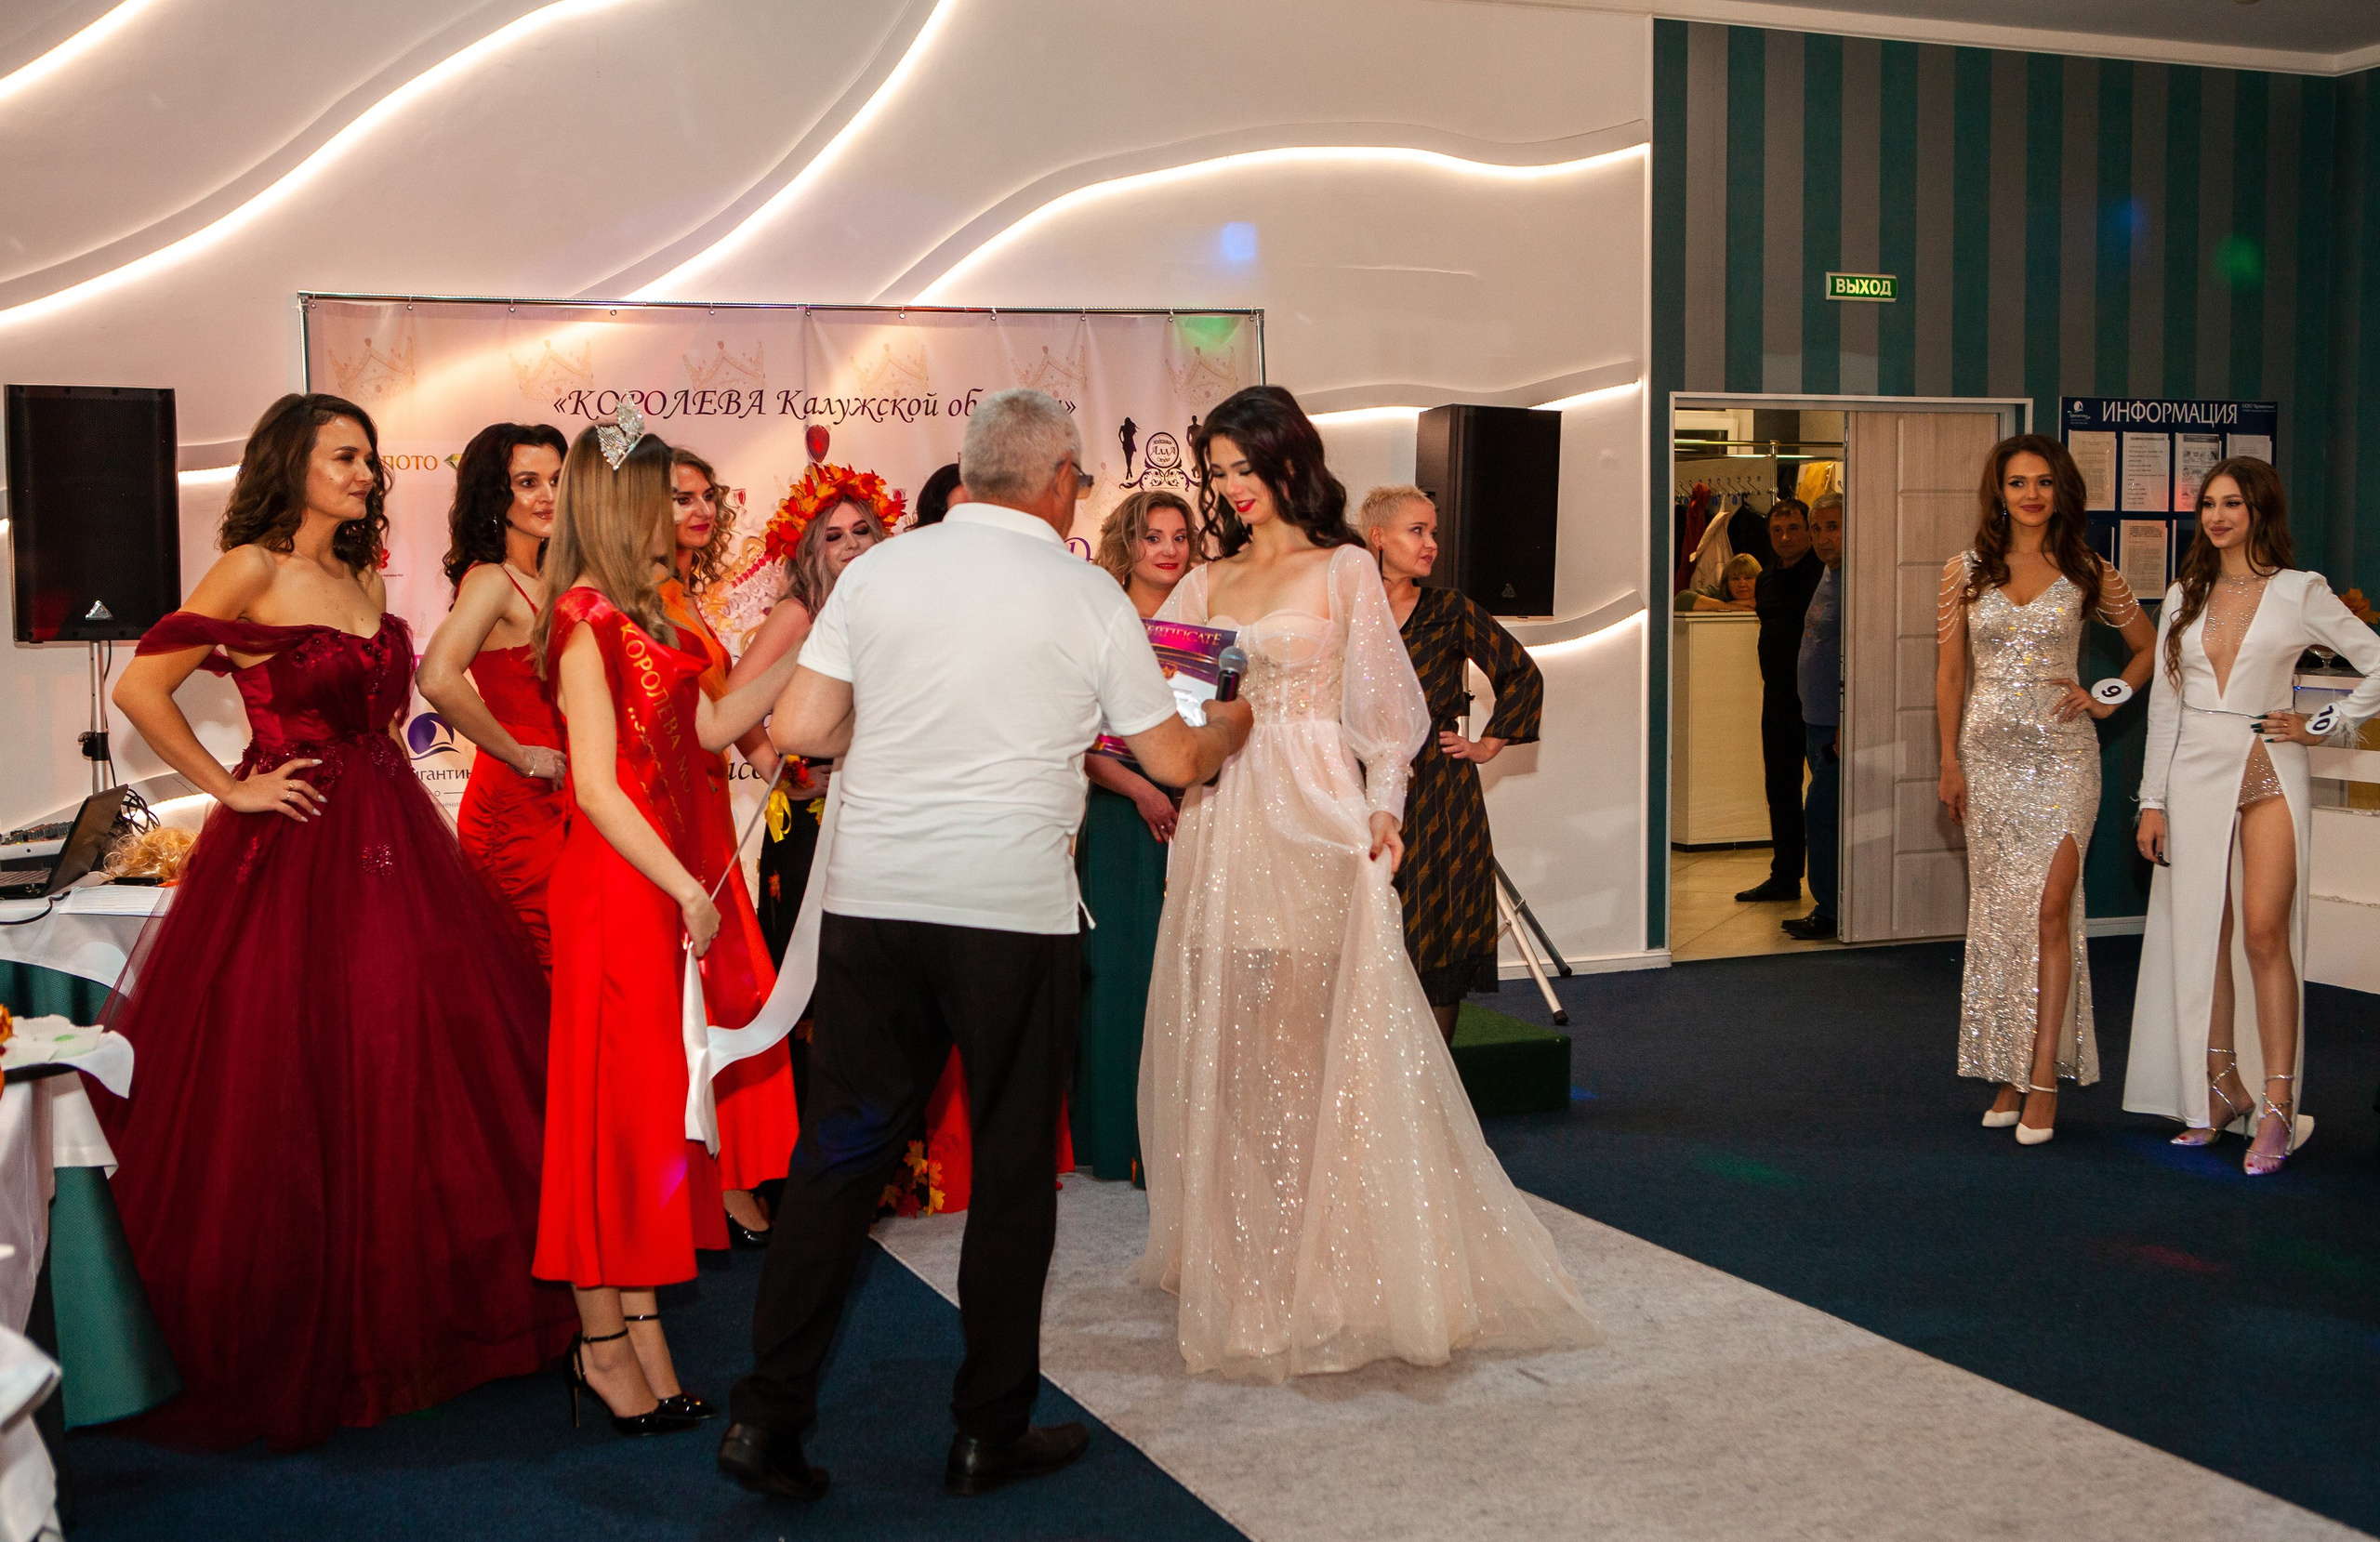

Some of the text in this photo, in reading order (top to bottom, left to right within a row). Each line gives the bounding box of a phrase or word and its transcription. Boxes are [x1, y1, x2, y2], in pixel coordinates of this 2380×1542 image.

[1835, 278, 1892, 297] ВЫХОД
[776, 389, 939, 425] Калужской
[2102, 401, 2238, 428] ИНФОРМАЦИЯ
[620, 622, 681, 751] КОРОЛЕВА
[2101, 685, 2122, 698] 9
[2312, 705, 2334, 731] 10
